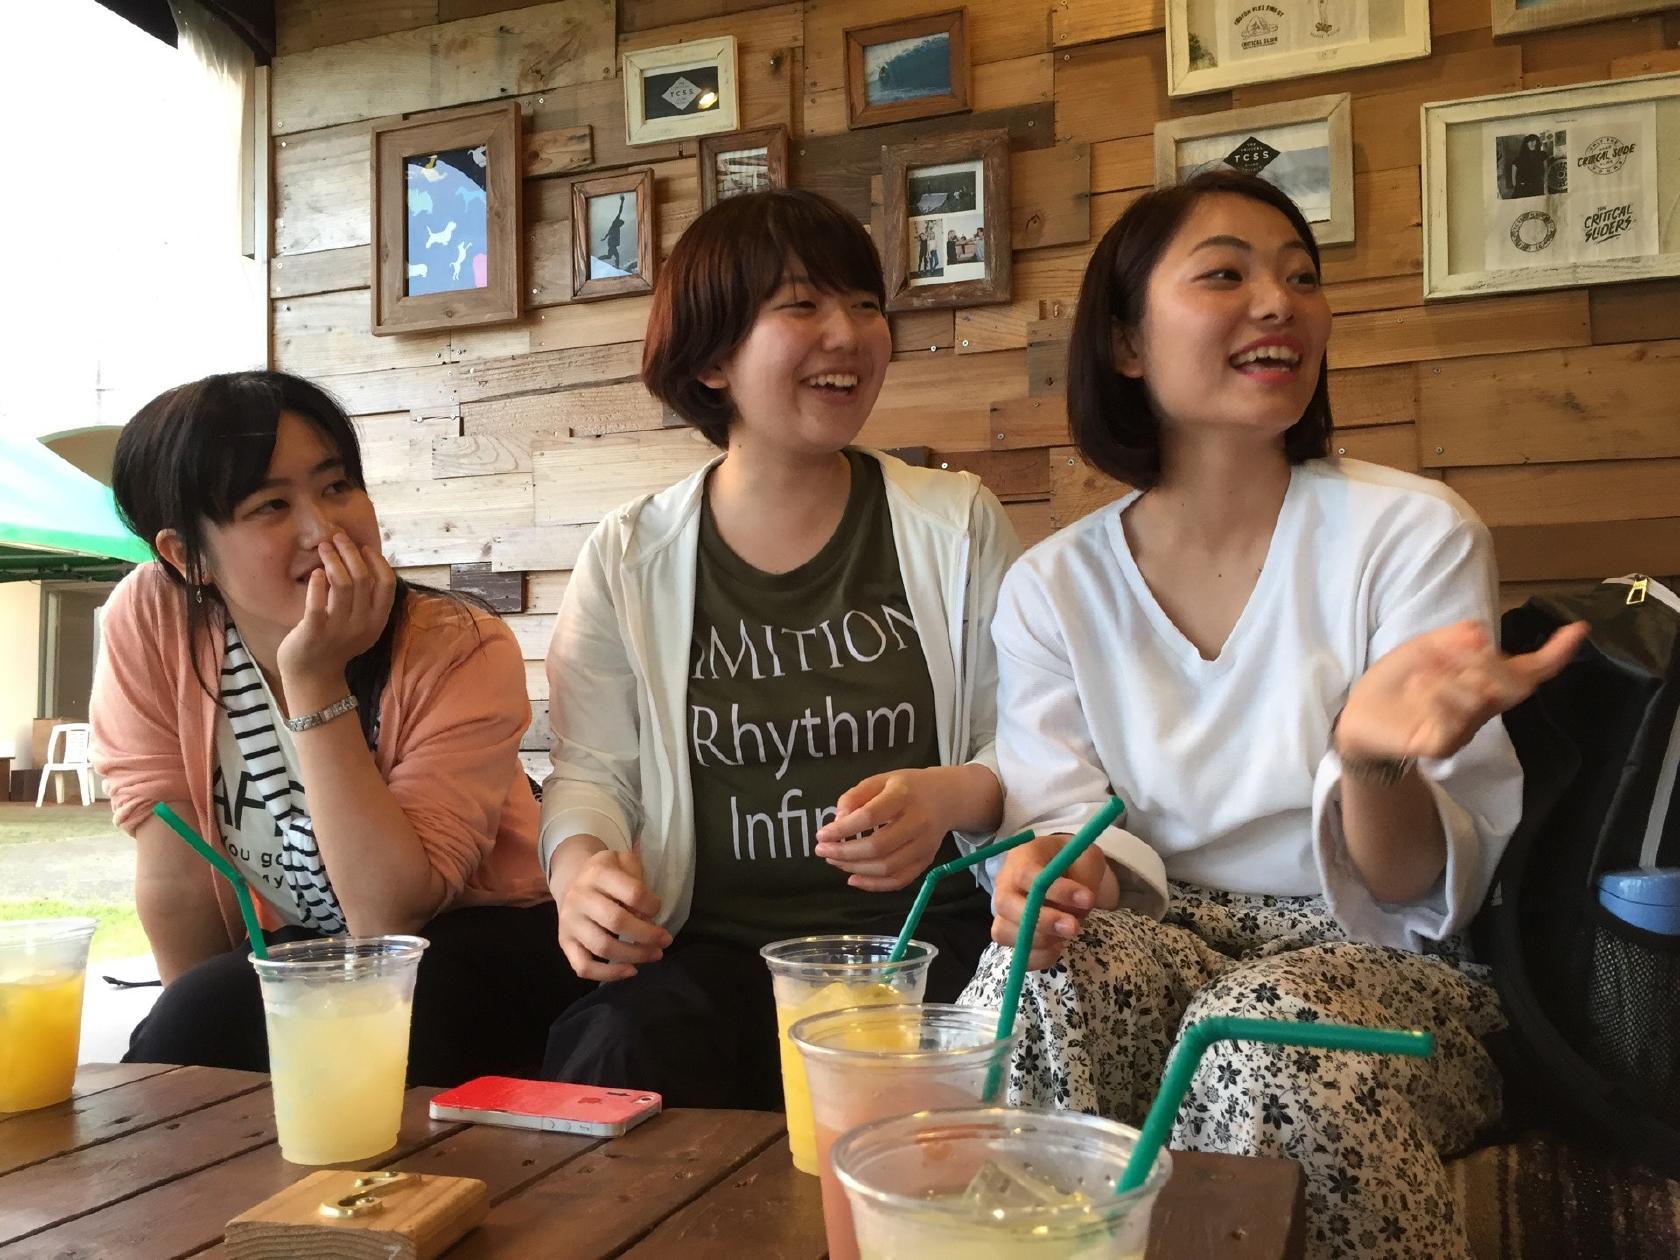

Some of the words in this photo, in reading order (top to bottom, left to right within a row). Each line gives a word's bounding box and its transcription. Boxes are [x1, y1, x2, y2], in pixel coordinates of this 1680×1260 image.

[670, 88, 694, 98] TCSS
[1234, 150, 1269, 164] TCSS
[1577, 150, 1610, 168] CRITICAL
[1584, 204, 1633, 229] CRITICAL
[1585, 215, 1632, 243] SLIDERS
[691, 695, 915, 780] Rhythm
